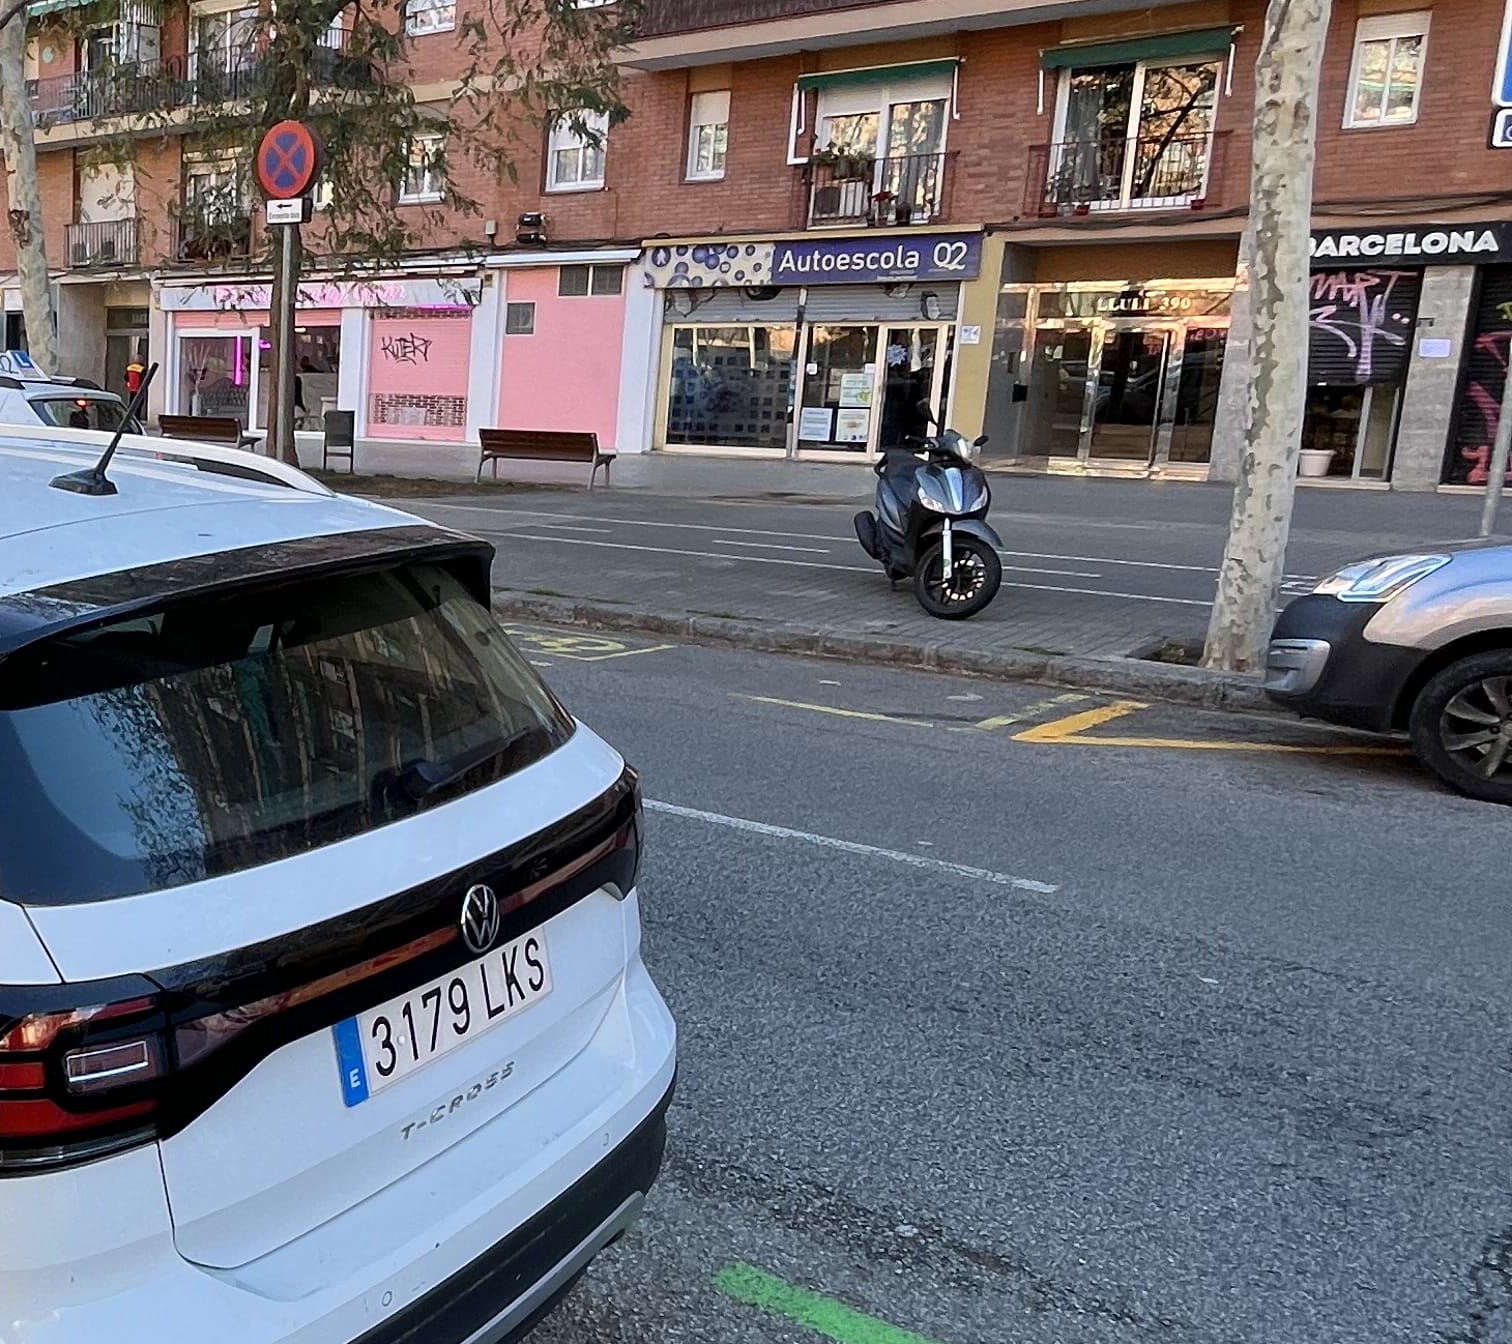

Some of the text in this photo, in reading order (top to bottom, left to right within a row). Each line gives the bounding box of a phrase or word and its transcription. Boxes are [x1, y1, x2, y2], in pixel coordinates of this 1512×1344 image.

[778, 244, 920, 272] Autoescola
[1158, 296, 1192, 310] 390
[371, 937, 545, 1078] 3179 LKS
[348, 1068, 361, 1089] E
[399, 1060, 517, 1141] T-CROSS
